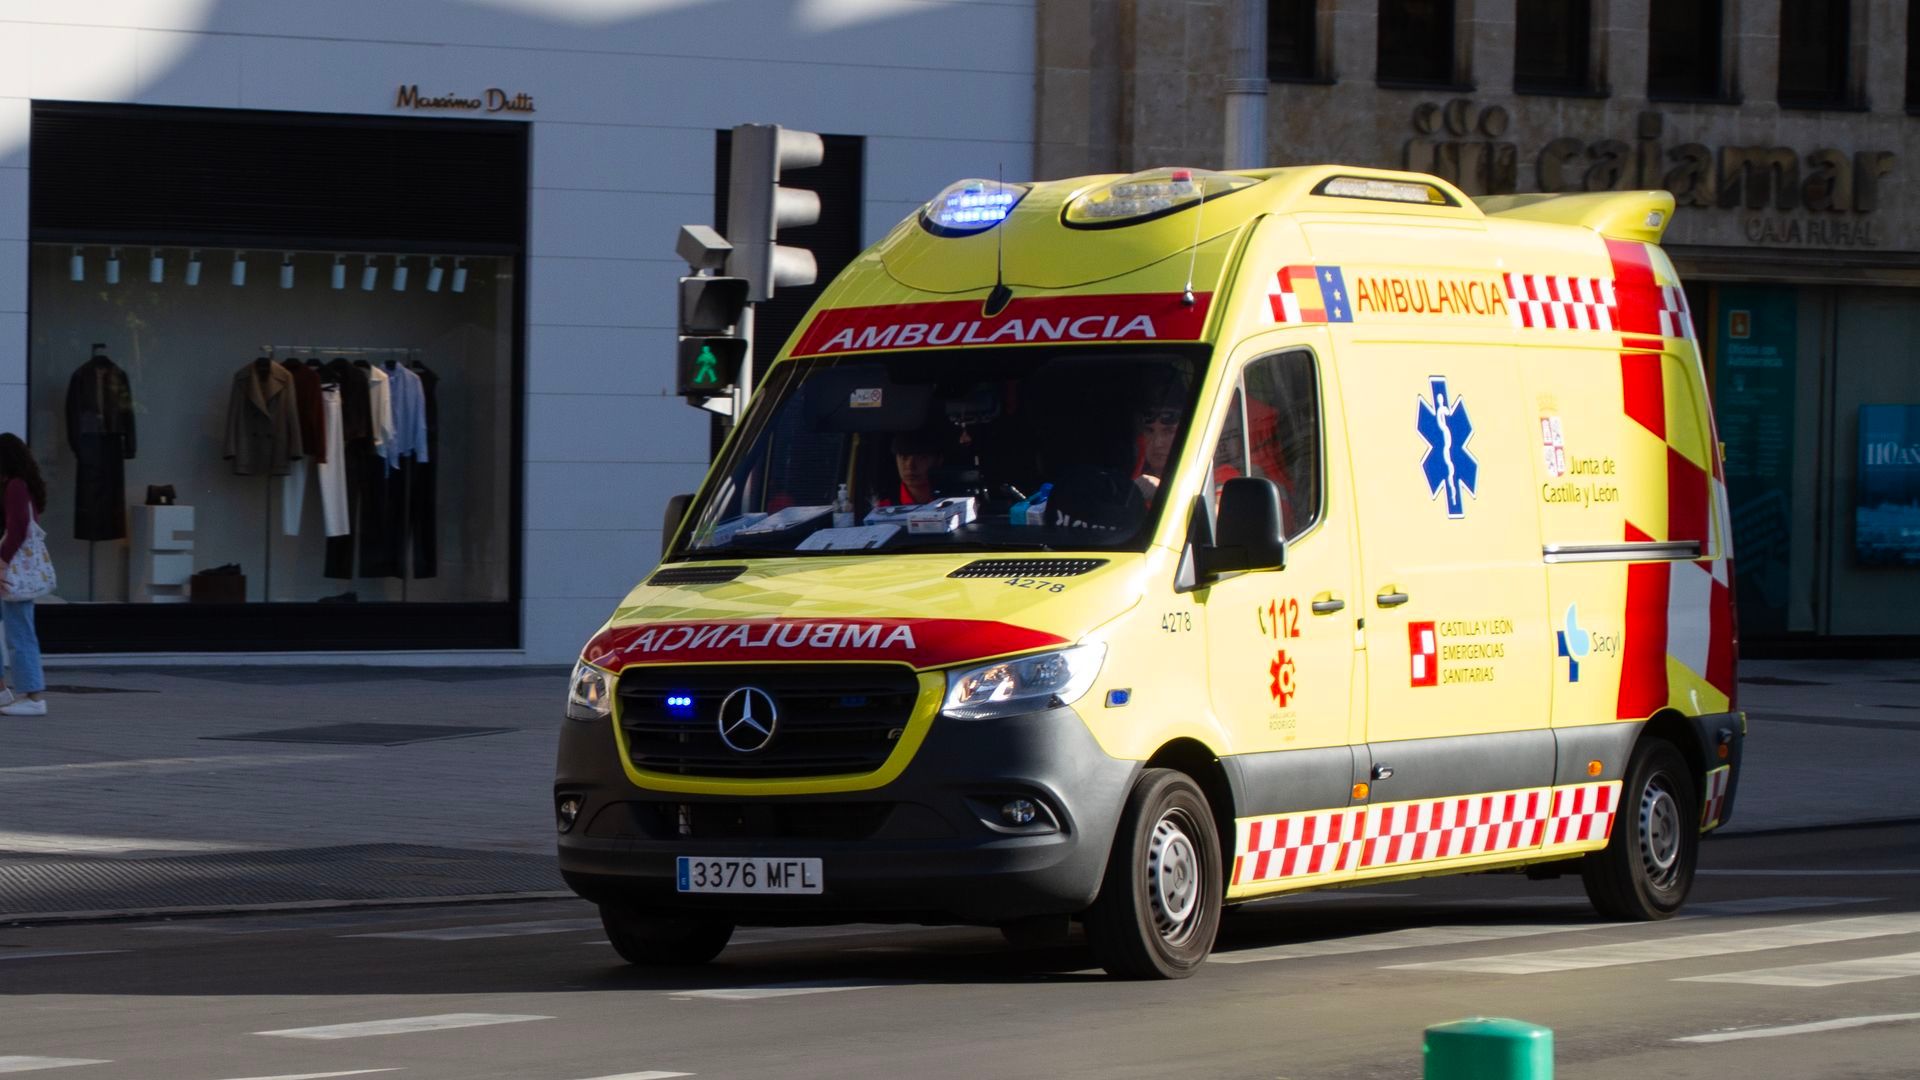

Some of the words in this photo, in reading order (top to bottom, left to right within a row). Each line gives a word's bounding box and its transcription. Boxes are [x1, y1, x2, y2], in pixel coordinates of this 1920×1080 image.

[397, 84, 482, 109] Massimo
[485, 88, 536, 113] Dutti
[1537, 111, 1897, 213] cajamar
[1745, 217, 1801, 243] CAJA
[1806, 219, 1876, 247] RURAL
[1357, 277, 1508, 315] AMBULANCIA
[818, 314, 1156, 352] AMBULANCIA
[1570, 456, 1599, 474] Junta
[1602, 456, 1615, 474] de
[1542, 483, 1581, 502] Castilla
[1583, 487, 1589, 508] y
[1003, 577, 1066, 594] 4278
[1161, 611, 1192, 633] 4278
[1269, 598, 1300, 639] 112
[1440, 621, 1481, 637] CASTILLA
[1482, 621, 1488, 635] Y
[1443, 643, 1504, 661] EMERGENCIAS
[1592, 631, 1621, 658] Sacyl
[1443, 667, 1494, 684] SANITARIAS
[693, 861, 758, 888] 3376
[766, 861, 817, 888] MFL
